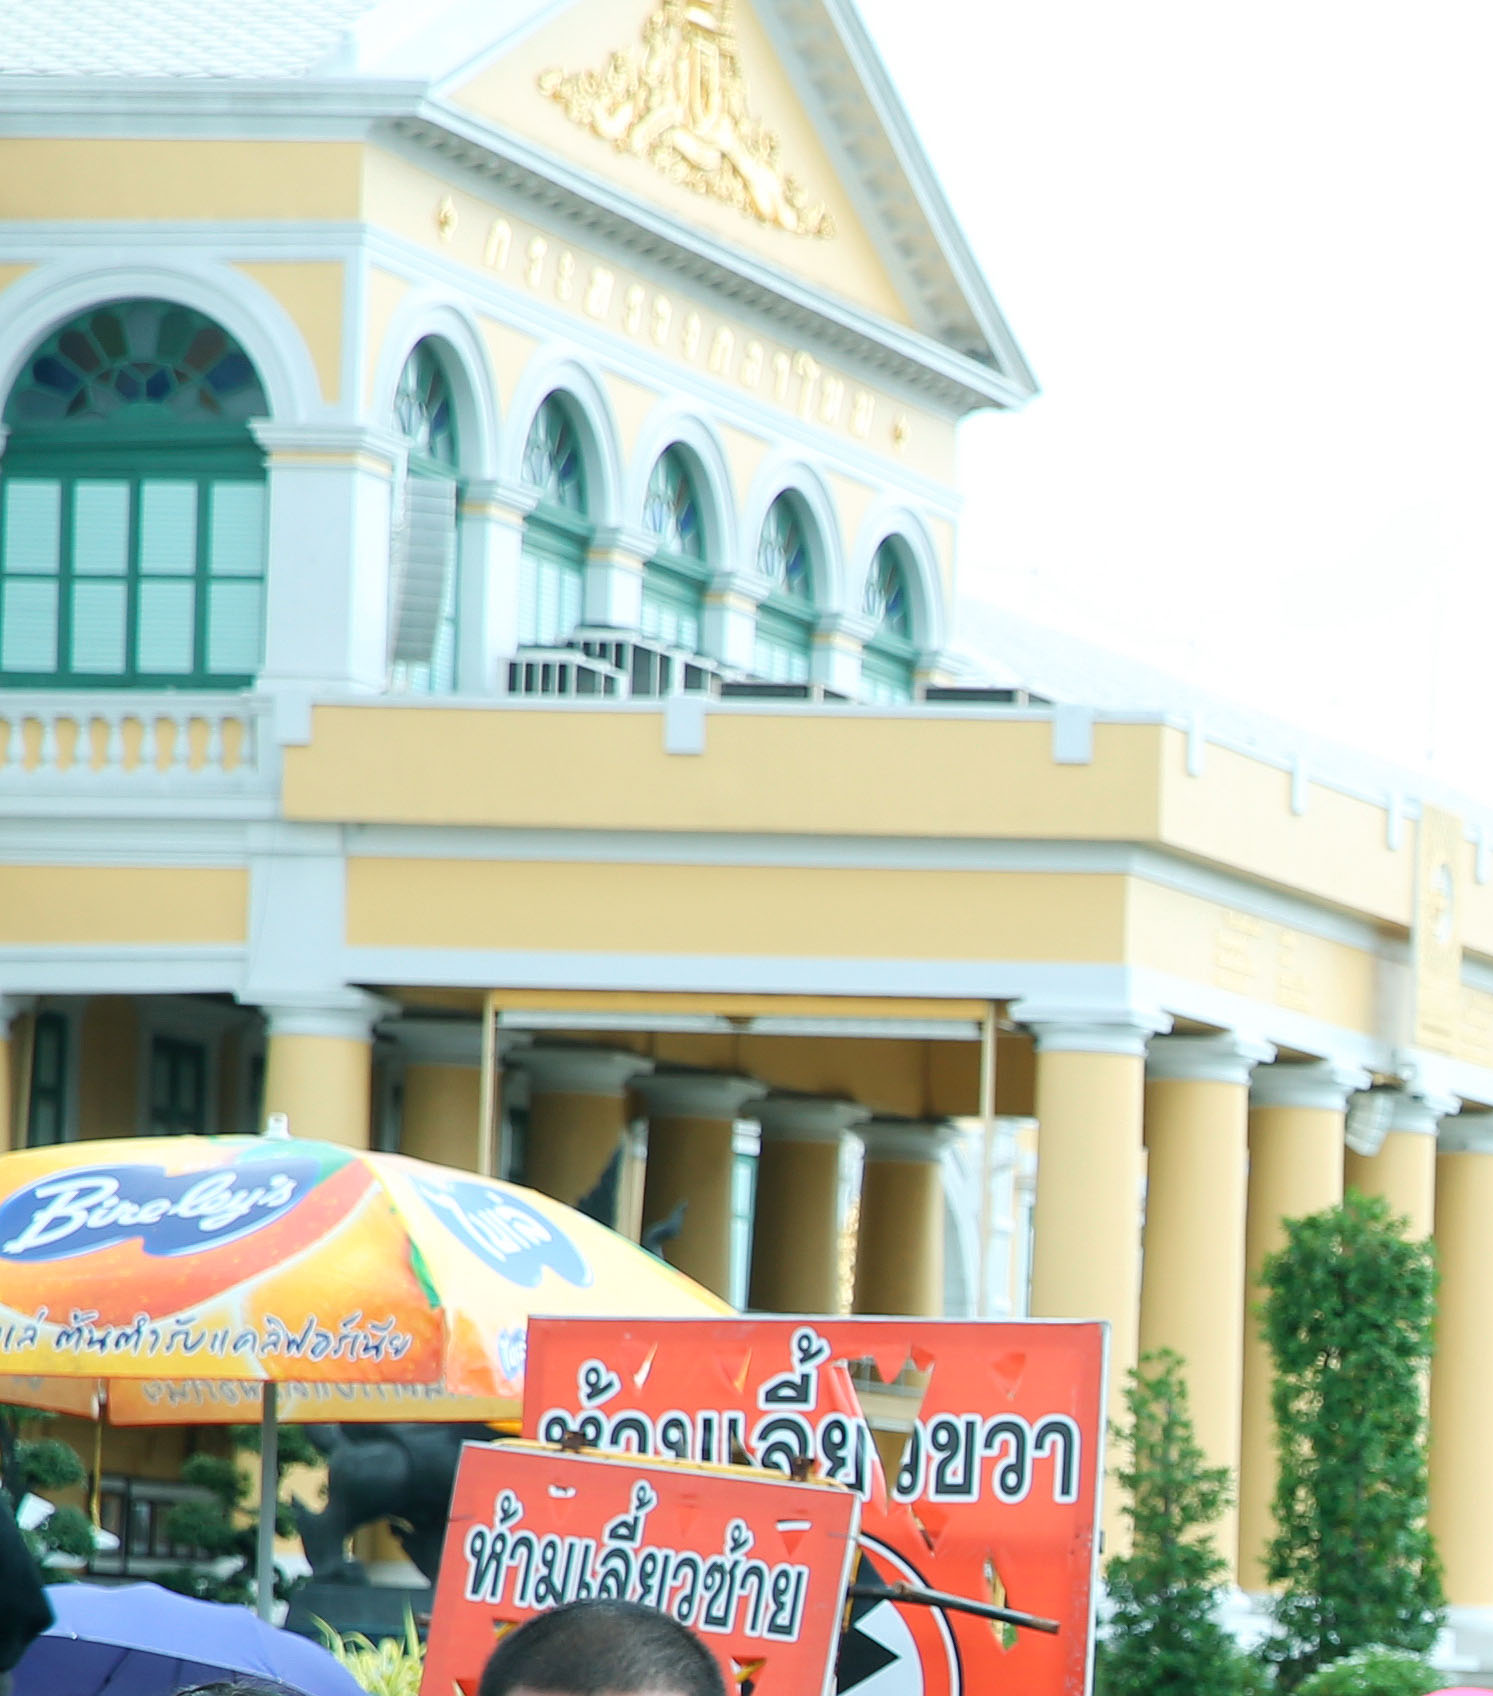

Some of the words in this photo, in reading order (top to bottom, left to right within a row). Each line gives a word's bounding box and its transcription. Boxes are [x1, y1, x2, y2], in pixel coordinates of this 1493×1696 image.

[466, 1480, 809, 1640] ห้ามเลี้ยวซ้าย
